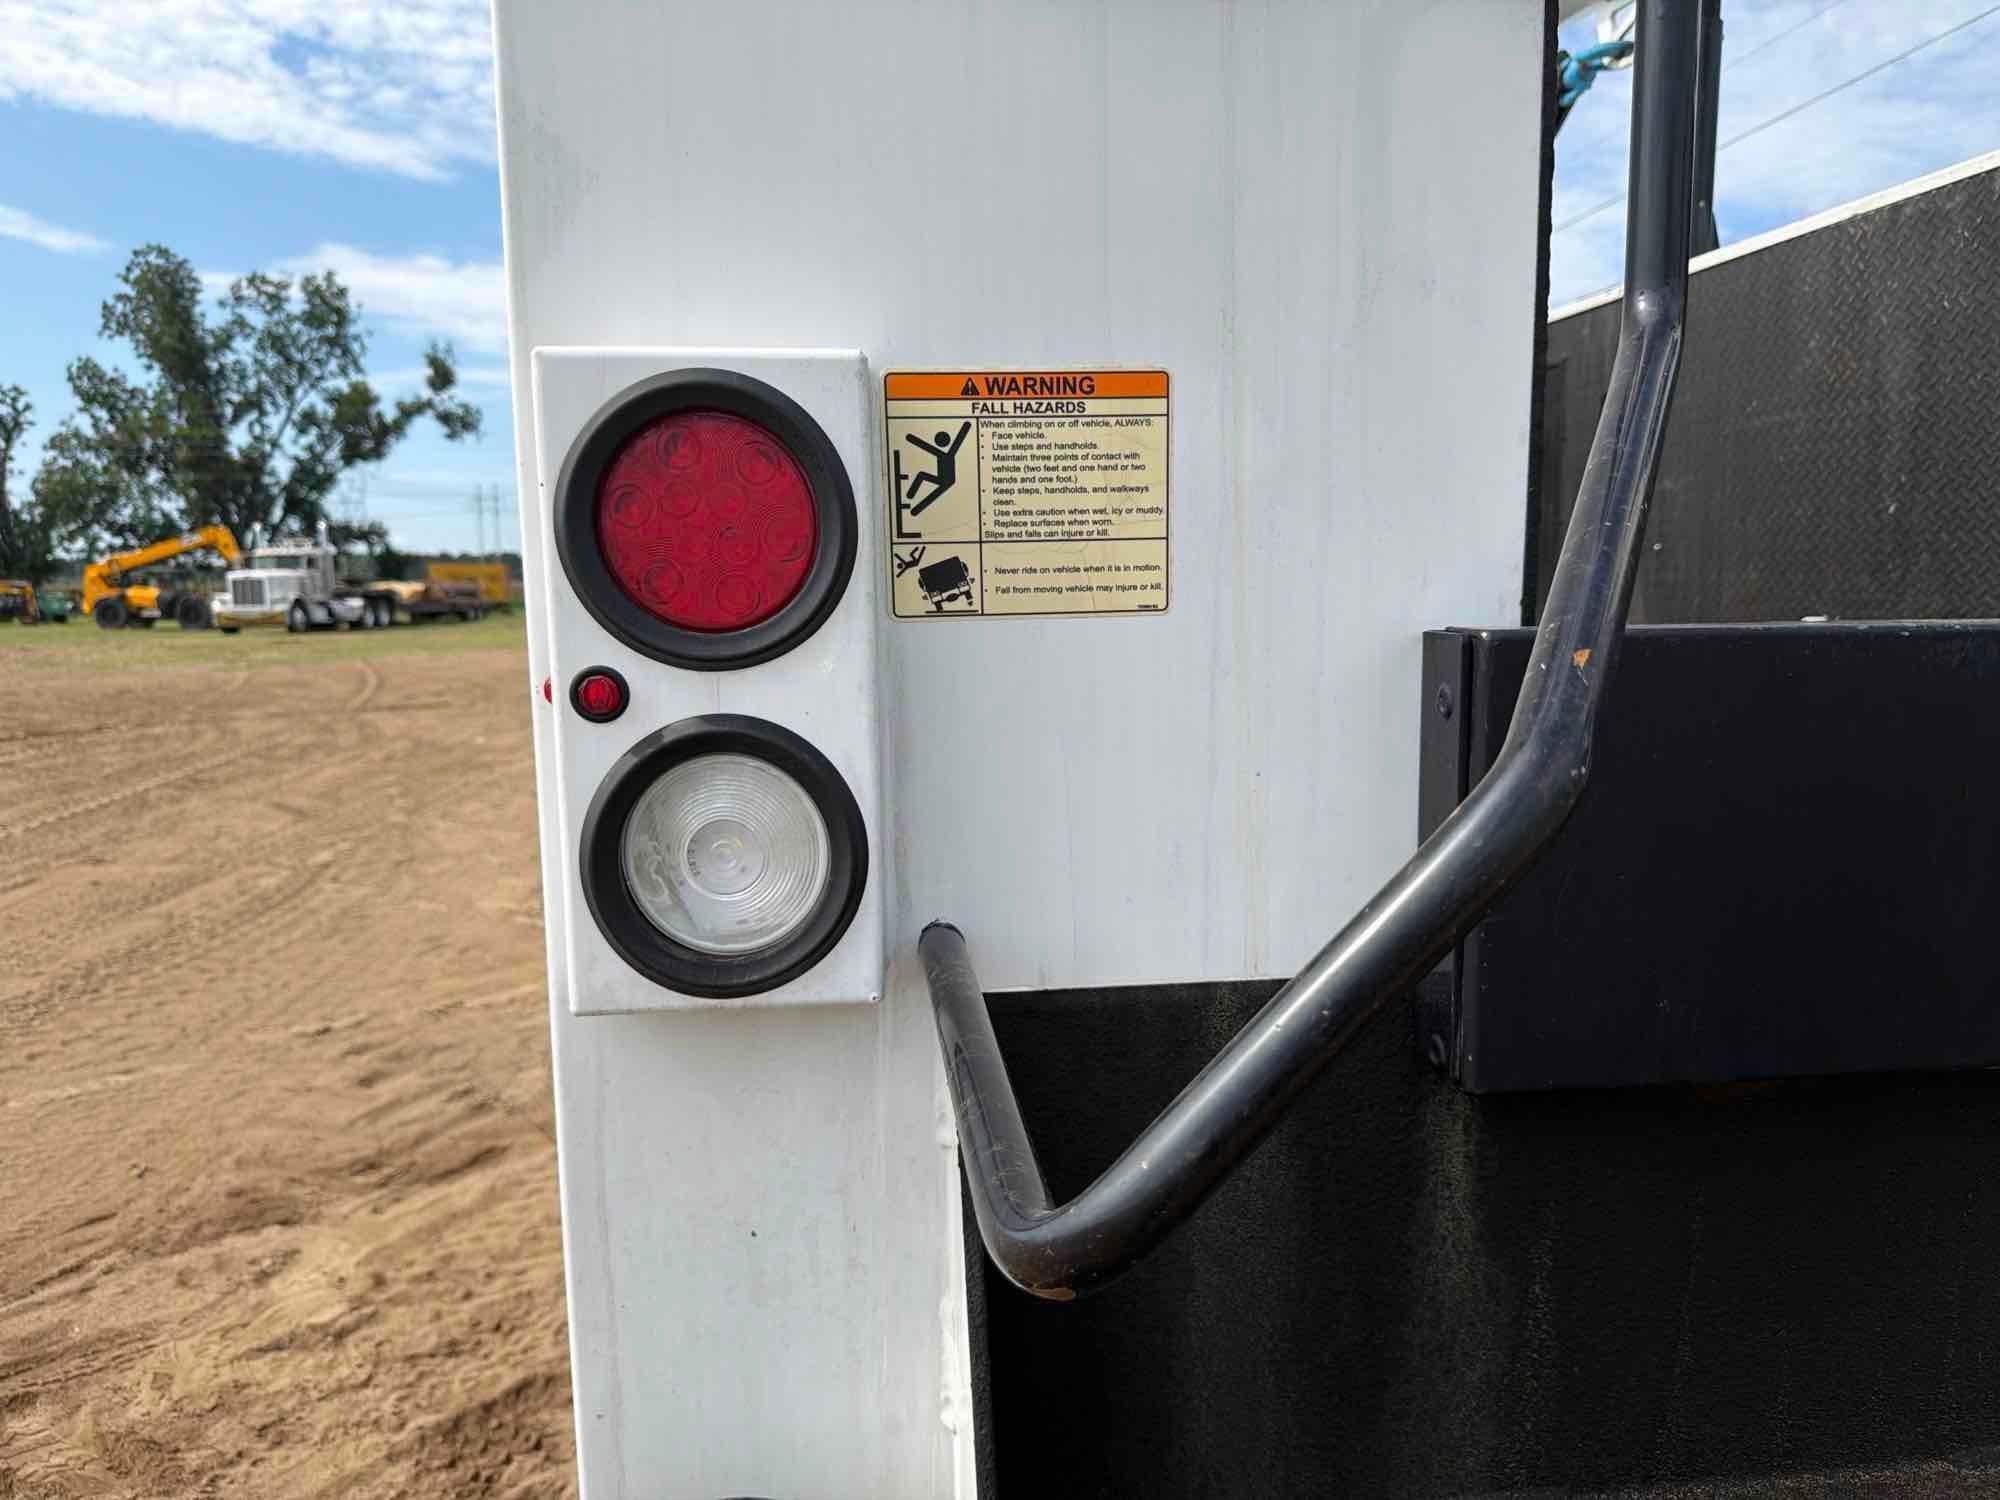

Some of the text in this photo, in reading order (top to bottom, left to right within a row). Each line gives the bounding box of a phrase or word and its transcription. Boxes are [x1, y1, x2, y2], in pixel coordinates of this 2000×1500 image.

[984, 376, 1095, 395] WARNING
[972, 402, 1086, 414] FALL HAZARDS
[1008, 421, 1042, 429] climbing
[1081, 420, 1112, 428] vehicle,
[1054, 454, 1078, 462] points
[1024, 465, 1041, 473] (two
[1062, 464, 1077, 472] and
[1056, 475, 1078, 484] foot.)
[993, 488, 1015, 496] Keep
[1044, 486, 1089, 494] handholds,
[1092, 486, 1108, 494] and
[1110, 485, 1149, 494] walkways
[994, 520, 1028, 528] Replace
[1030, 519, 1065, 527] surfaces
[1008, 530, 1022, 538] and
[1061, 529, 1083, 538] injure
[995, 567, 1020, 575] Never
[1022, 566, 1037, 574] ride
[1124, 564, 1131, 572] in
[995, 586, 1010, 594] Fall
[1034, 586, 1062, 594] moving
[1096, 584, 1113, 593] may
[1116, 584, 1137, 592] injure
